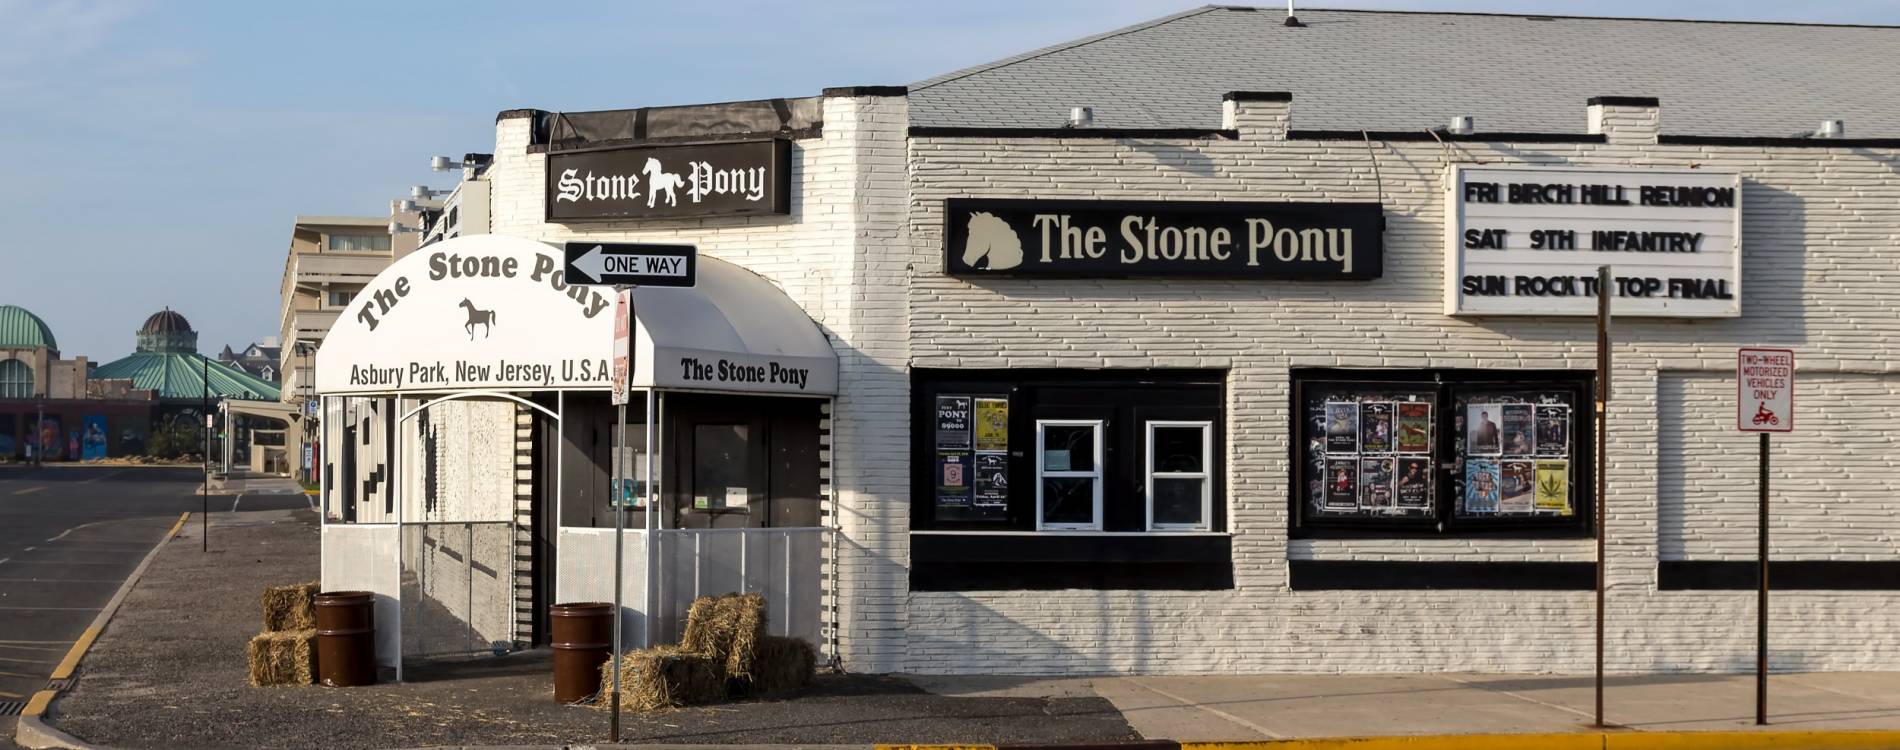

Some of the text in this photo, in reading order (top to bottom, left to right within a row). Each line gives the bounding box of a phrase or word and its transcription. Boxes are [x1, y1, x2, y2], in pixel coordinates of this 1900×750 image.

[556, 161, 767, 203] Stone Pony
[1464, 182, 1735, 208] FRI BIRCH HILL REUNION
[1032, 213, 1353, 273] The Stone Pony
[1464, 228, 1703, 253] SAT 9TH INFANTRY
[604, 256, 682, 274] ONE WAY
[357, 252, 610, 332] The Stone Pony
[1462, 275, 1506, 297] SUN
[1515, 275, 1575, 297] ROCK
[1615, 276, 1661, 297] TOP
[1668, 278, 1733, 299] FINAL
[1741, 354, 1790, 366] TWO-WHEEL
[1743, 366, 1789, 377] MOTORIZED
[350, 363, 404, 389] Asbury
[409, 361, 449, 386] Park,
[455, 360, 491, 382] New
[495, 359, 555, 386] Jersey,
[680, 357, 809, 390] The Stone Pony
[1746, 378, 1785, 389] VEHICLES
[1753, 389, 1777, 400] ONLY
[938, 410, 968, 419] PONY
